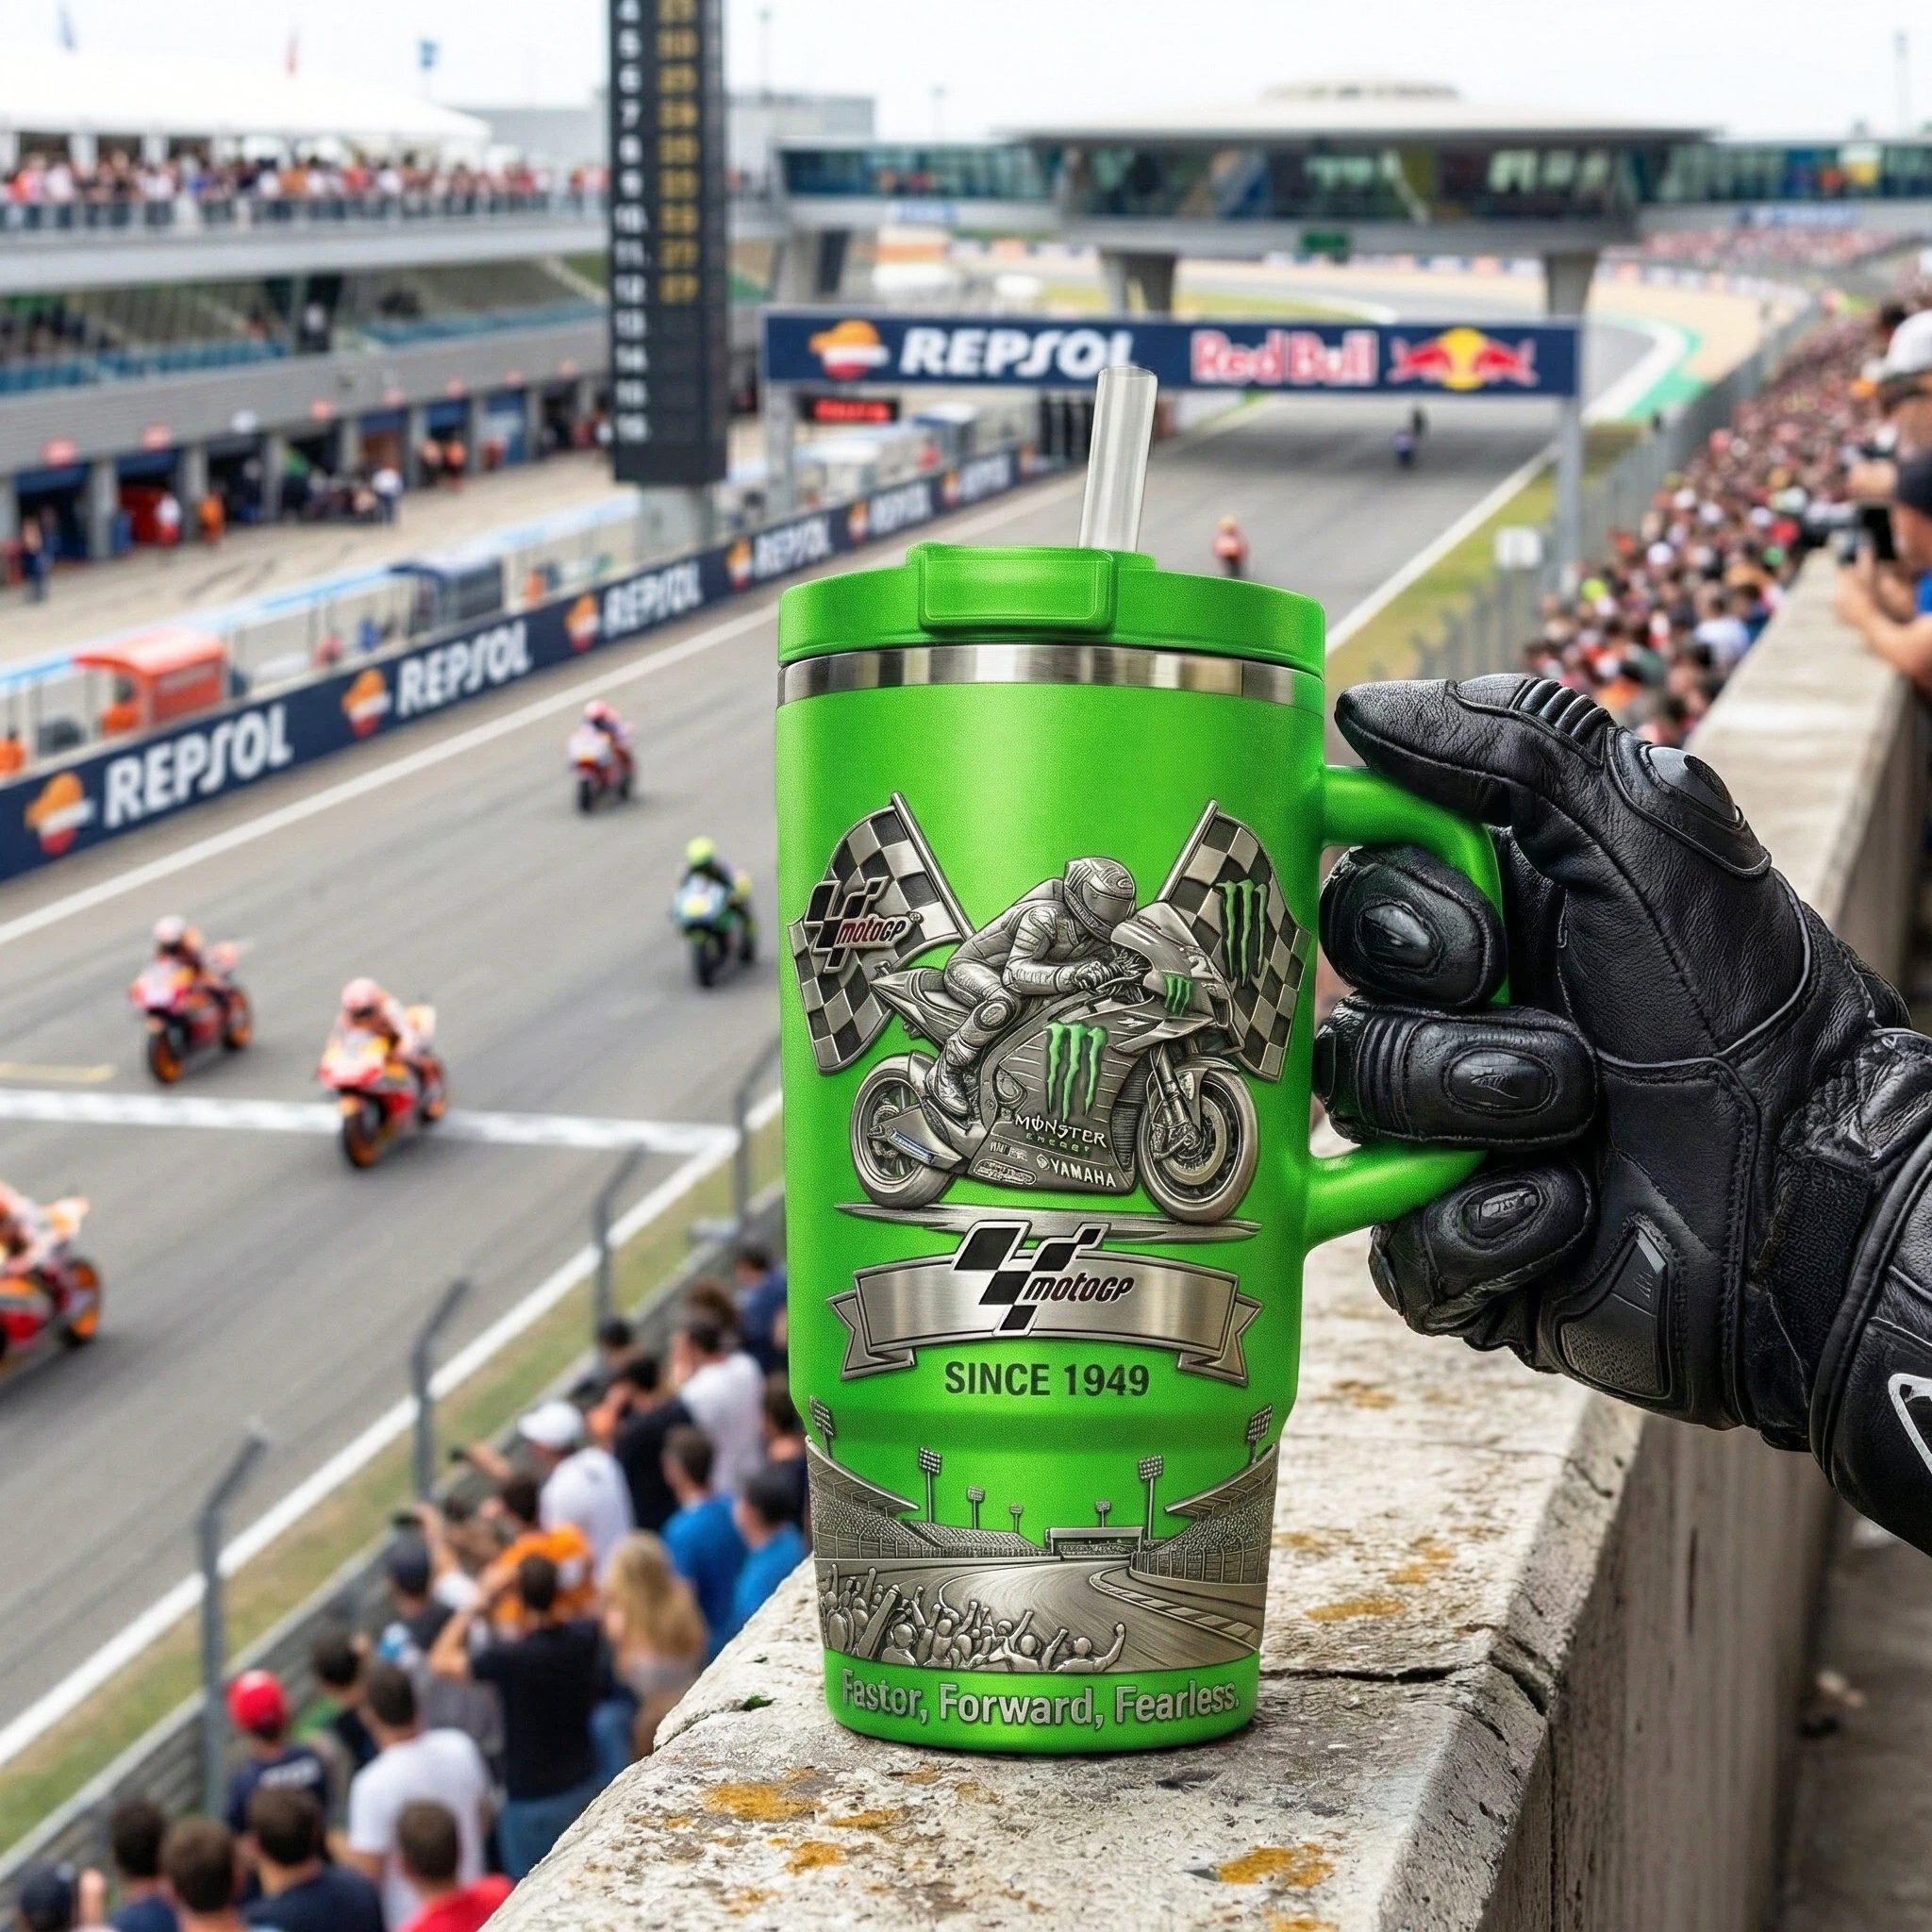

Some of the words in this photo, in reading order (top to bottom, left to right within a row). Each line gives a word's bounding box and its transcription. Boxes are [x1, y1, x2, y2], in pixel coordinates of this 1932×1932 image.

[899, 327, 1138, 378] REPSOL
[1191, 331, 1284, 386] Red
[1290, 331, 1379, 386] Bull
[396, 620, 533, 717] REPSOL
[103, 704, 293, 828] REPSOL
[1050, 1158, 1117, 1188] YAMAHA
[944, 1360, 1051, 1396] SINCE
[1064, 1363, 1150, 1396] 1949
[842, 1668, 927, 1724] Fastor,
[939, 1683, 1104, 1730] Forward,
[1115, 1680, 1240, 1724] Fearless.
